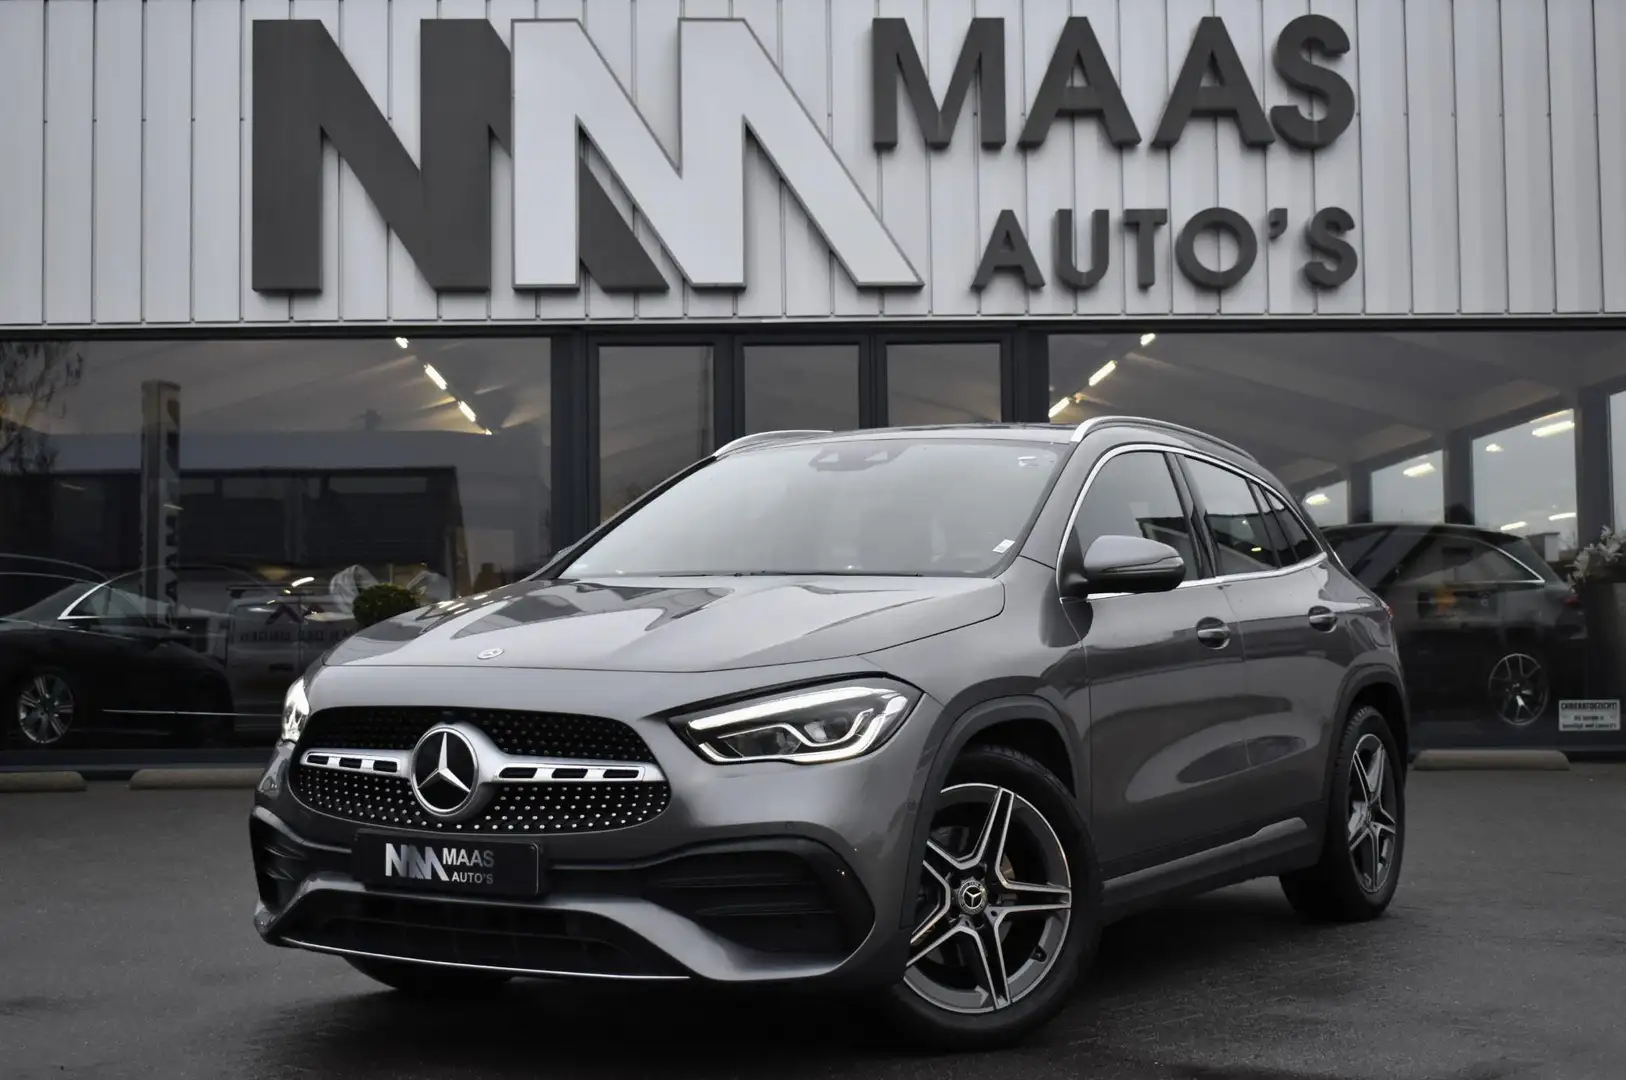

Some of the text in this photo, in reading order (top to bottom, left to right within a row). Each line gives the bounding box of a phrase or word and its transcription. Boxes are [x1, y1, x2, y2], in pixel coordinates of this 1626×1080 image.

[873, 14, 1355, 150] MAAS
[970, 207, 1358, 290] AUTO'S
[442, 847, 494, 868] MAAS
[451, 871, 494, 884] AUTO'S
